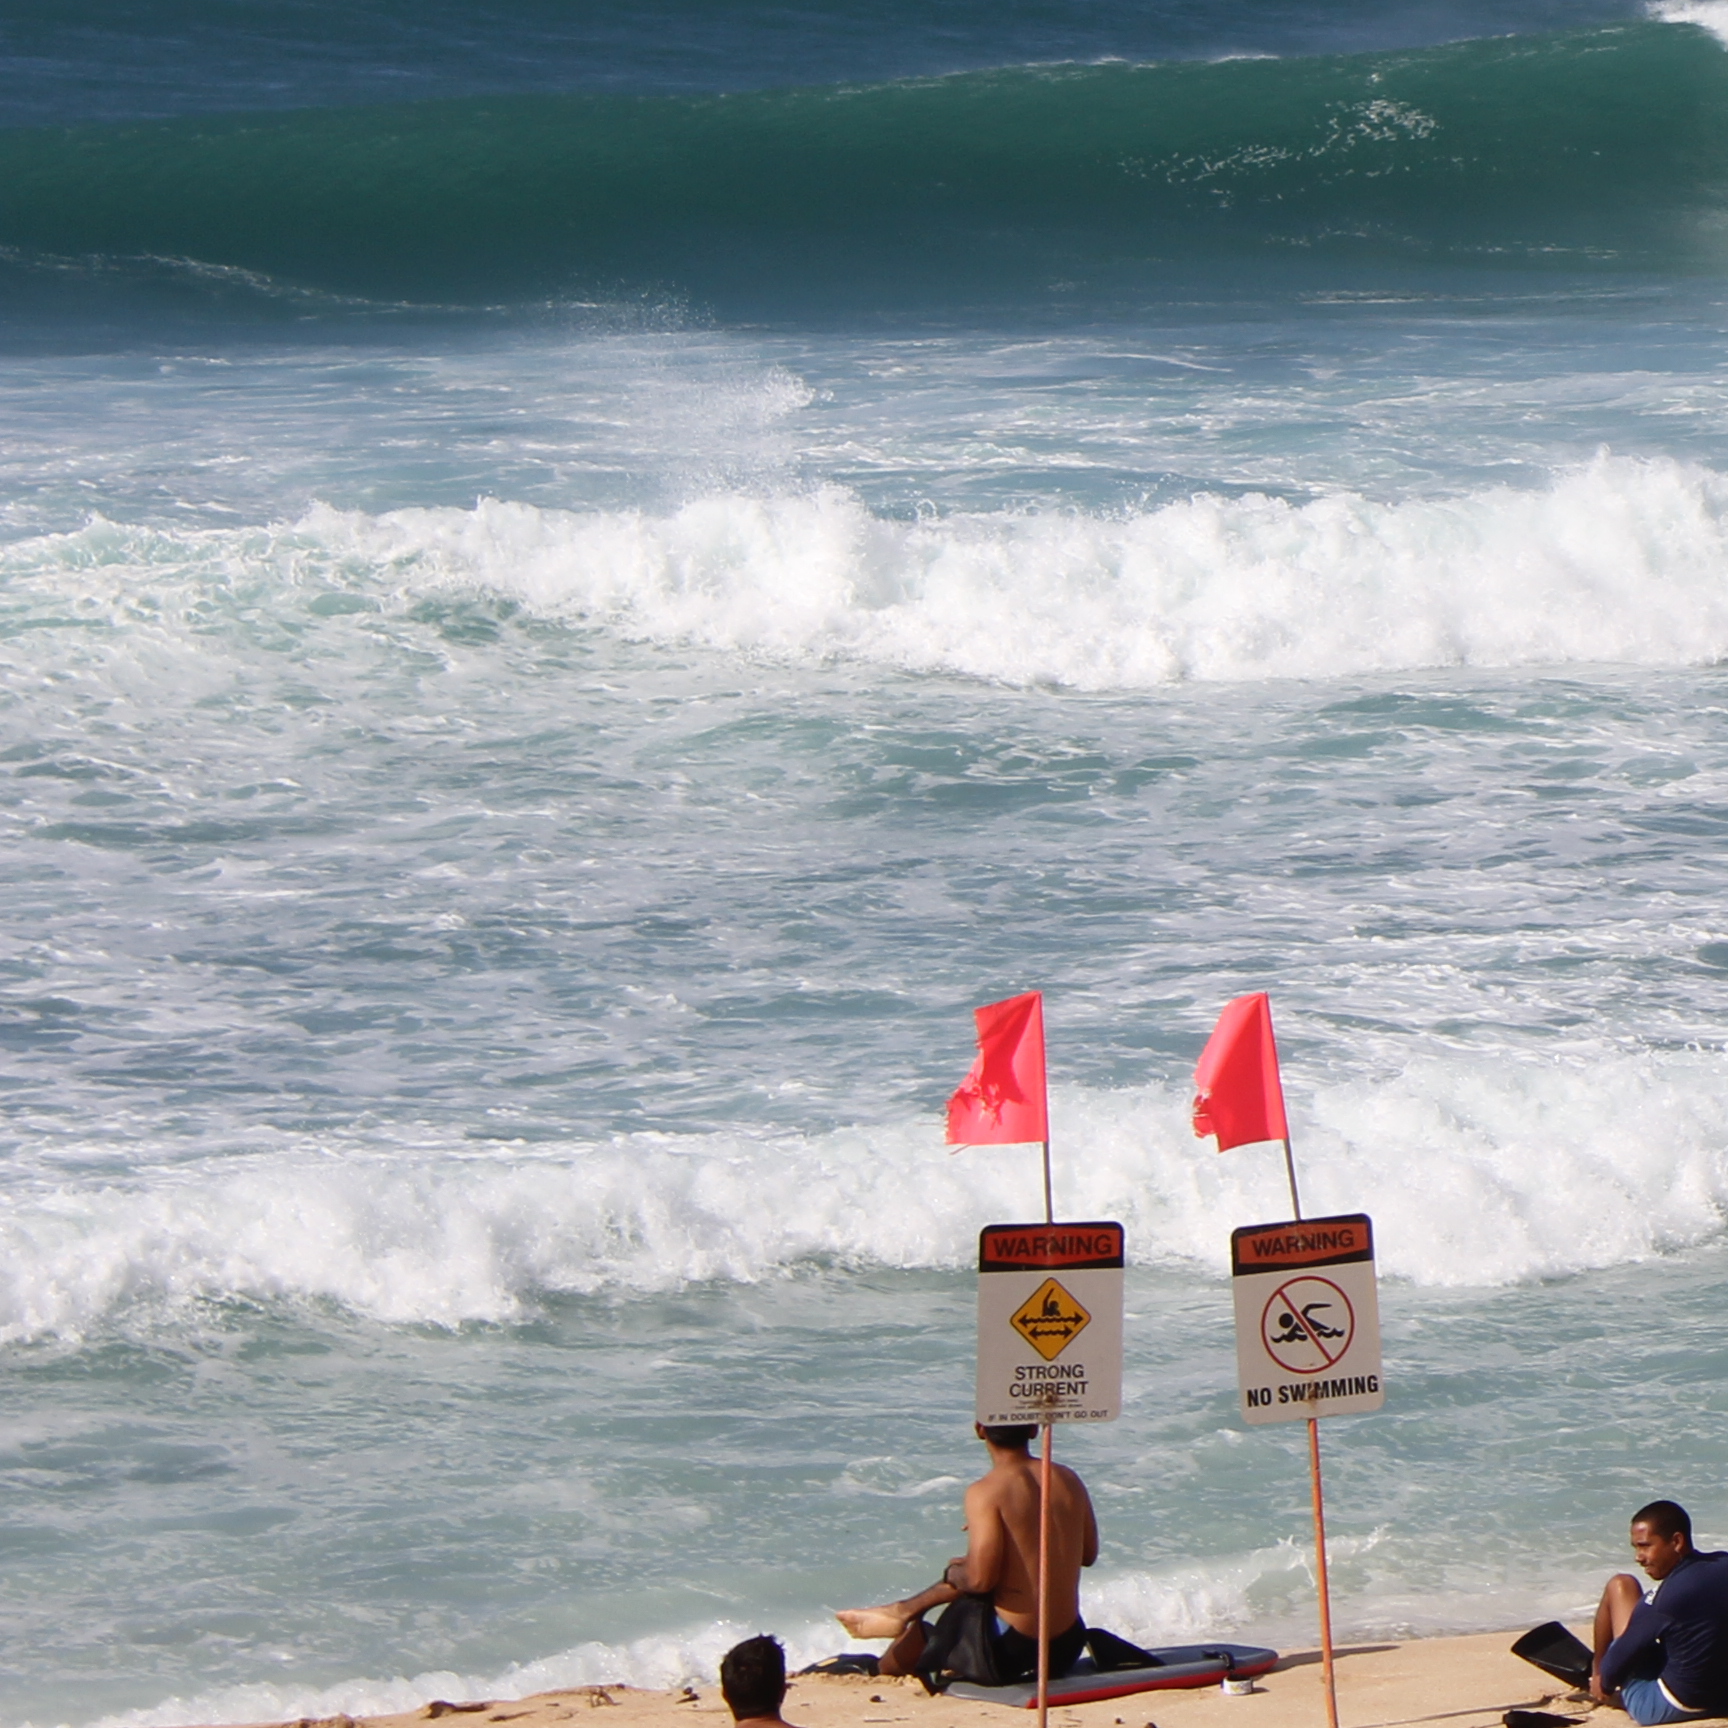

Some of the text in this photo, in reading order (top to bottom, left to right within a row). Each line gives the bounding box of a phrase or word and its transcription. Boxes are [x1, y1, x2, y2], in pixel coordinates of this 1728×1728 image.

[993, 1234, 1112, 1257] WARNING
[1252, 1229, 1354, 1257] WARNING
[1015, 1364, 1085, 1381] STRONG
[1009, 1381, 1089, 1398] CURRENT
[1247, 1375, 1378, 1407] NO SWIMMING
[988, 1414, 997, 1422] IF
[998, 1413, 1008, 1421] IN
[1074, 1410, 1088, 1419] GO
[1090, 1410, 1108, 1418] OUT
